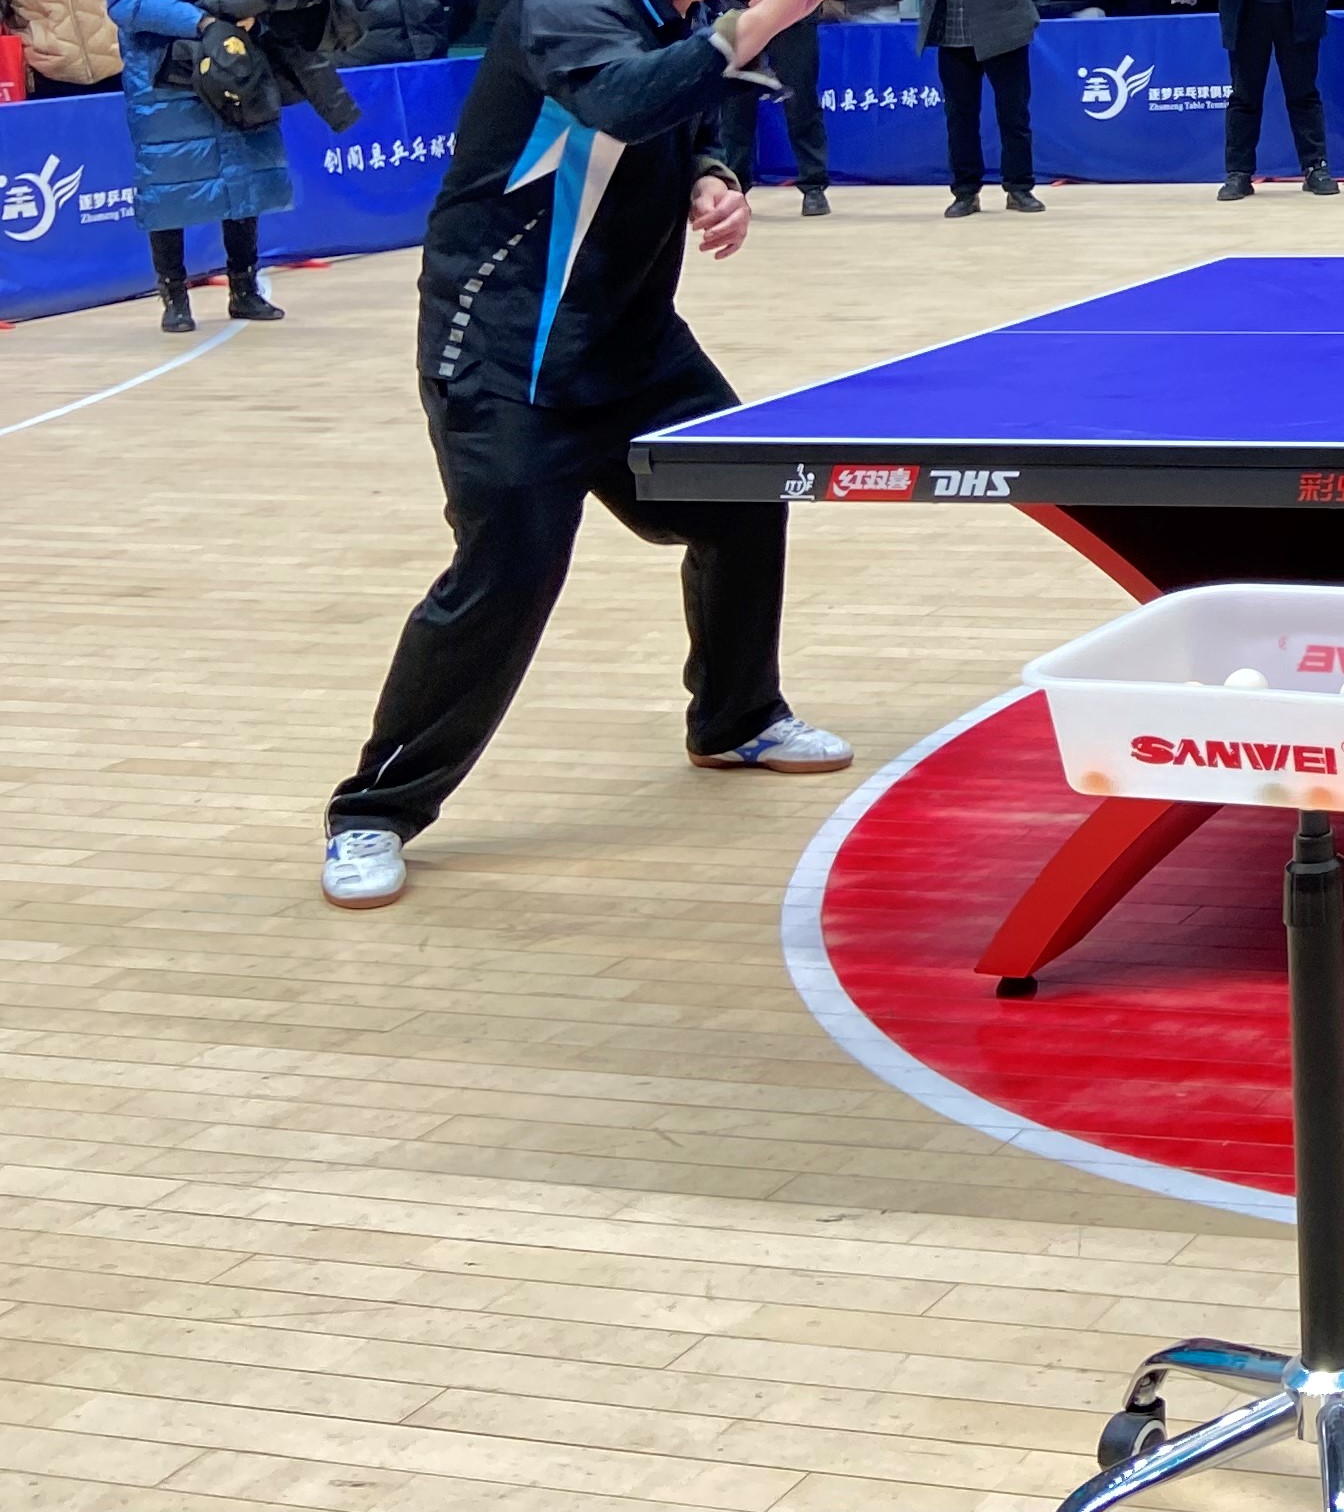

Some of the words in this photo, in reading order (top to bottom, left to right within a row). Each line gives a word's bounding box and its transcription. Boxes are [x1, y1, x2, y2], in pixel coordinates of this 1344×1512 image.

[821, 86, 942, 111] 阁县乒乓球协
[1148, 85, 1234, 101] 逐梦乒乓球俱乐
[79, 187, 137, 211] 逐梦乒乓
[832, 468, 912, 497] 红双喜
[930, 470, 1020, 497] DHS
[1130, 734, 1338, 776] SANWEI
